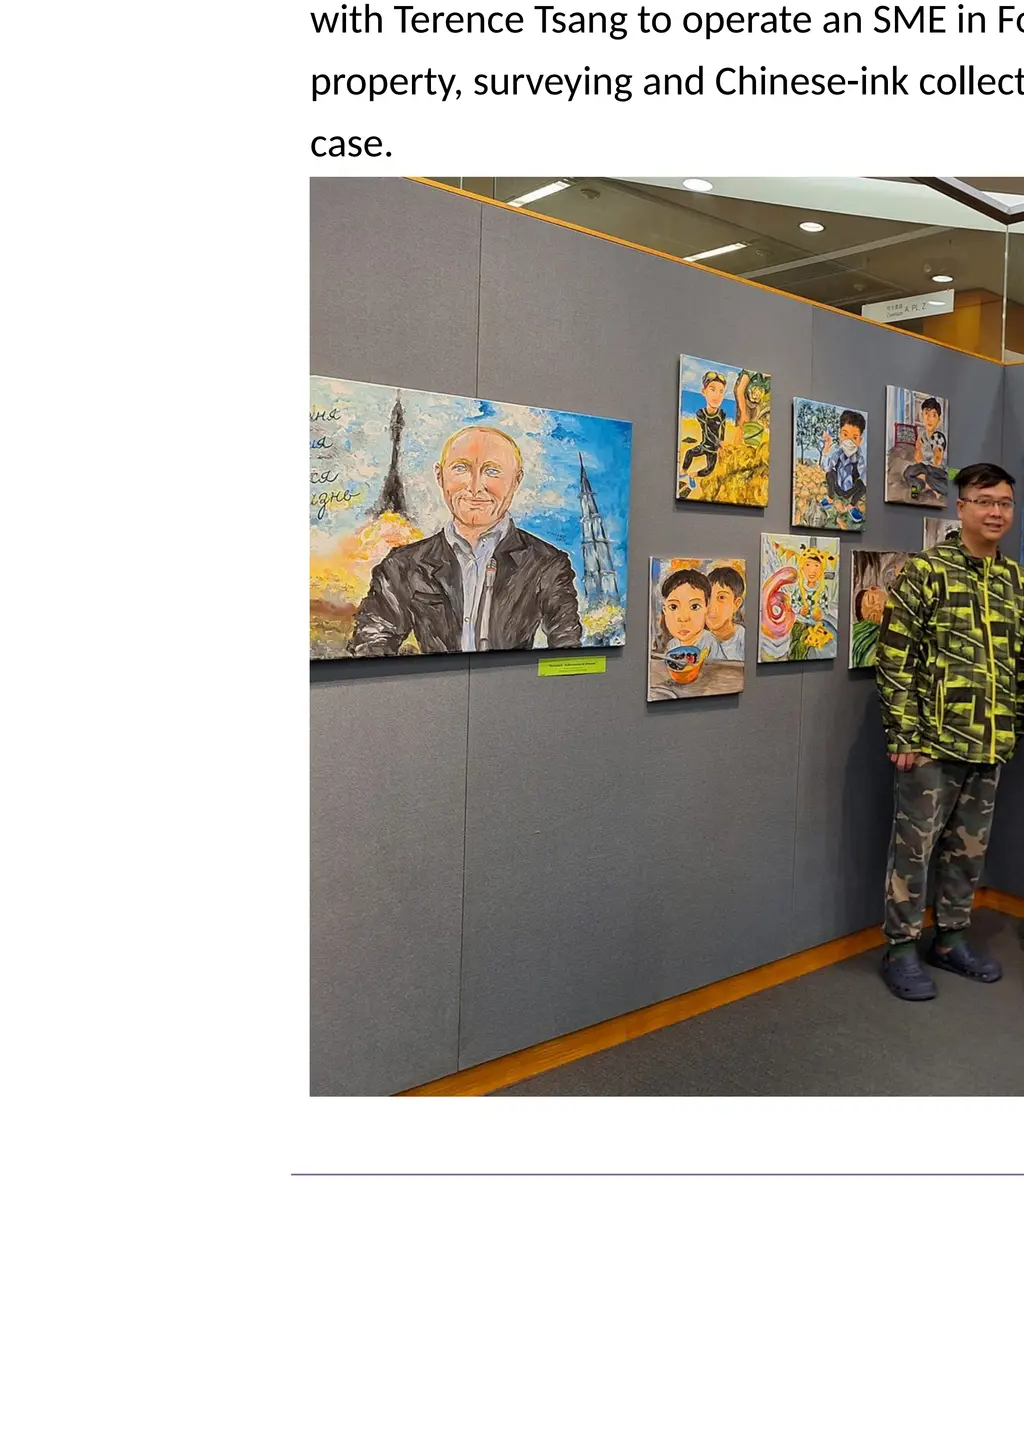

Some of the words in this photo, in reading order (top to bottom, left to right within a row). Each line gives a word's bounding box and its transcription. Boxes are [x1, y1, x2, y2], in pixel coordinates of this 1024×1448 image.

[311, 4, 382, 33] with
[394, 6, 523, 33] Terence
[534, 6, 627, 40] Tsang
[638, 6, 671, 33] to
[683, 6, 811, 39] operate
[823, 12, 861, 33] an
[874, 6, 945, 33] SME
[958, 4, 985, 33] in
[313, 68, 461, 101] property,
[474, 66, 632, 102] surveying
[644, 66, 703, 95] and
[716, 66, 908, 95] Chinese-ink
[311, 136, 391, 157] case.
